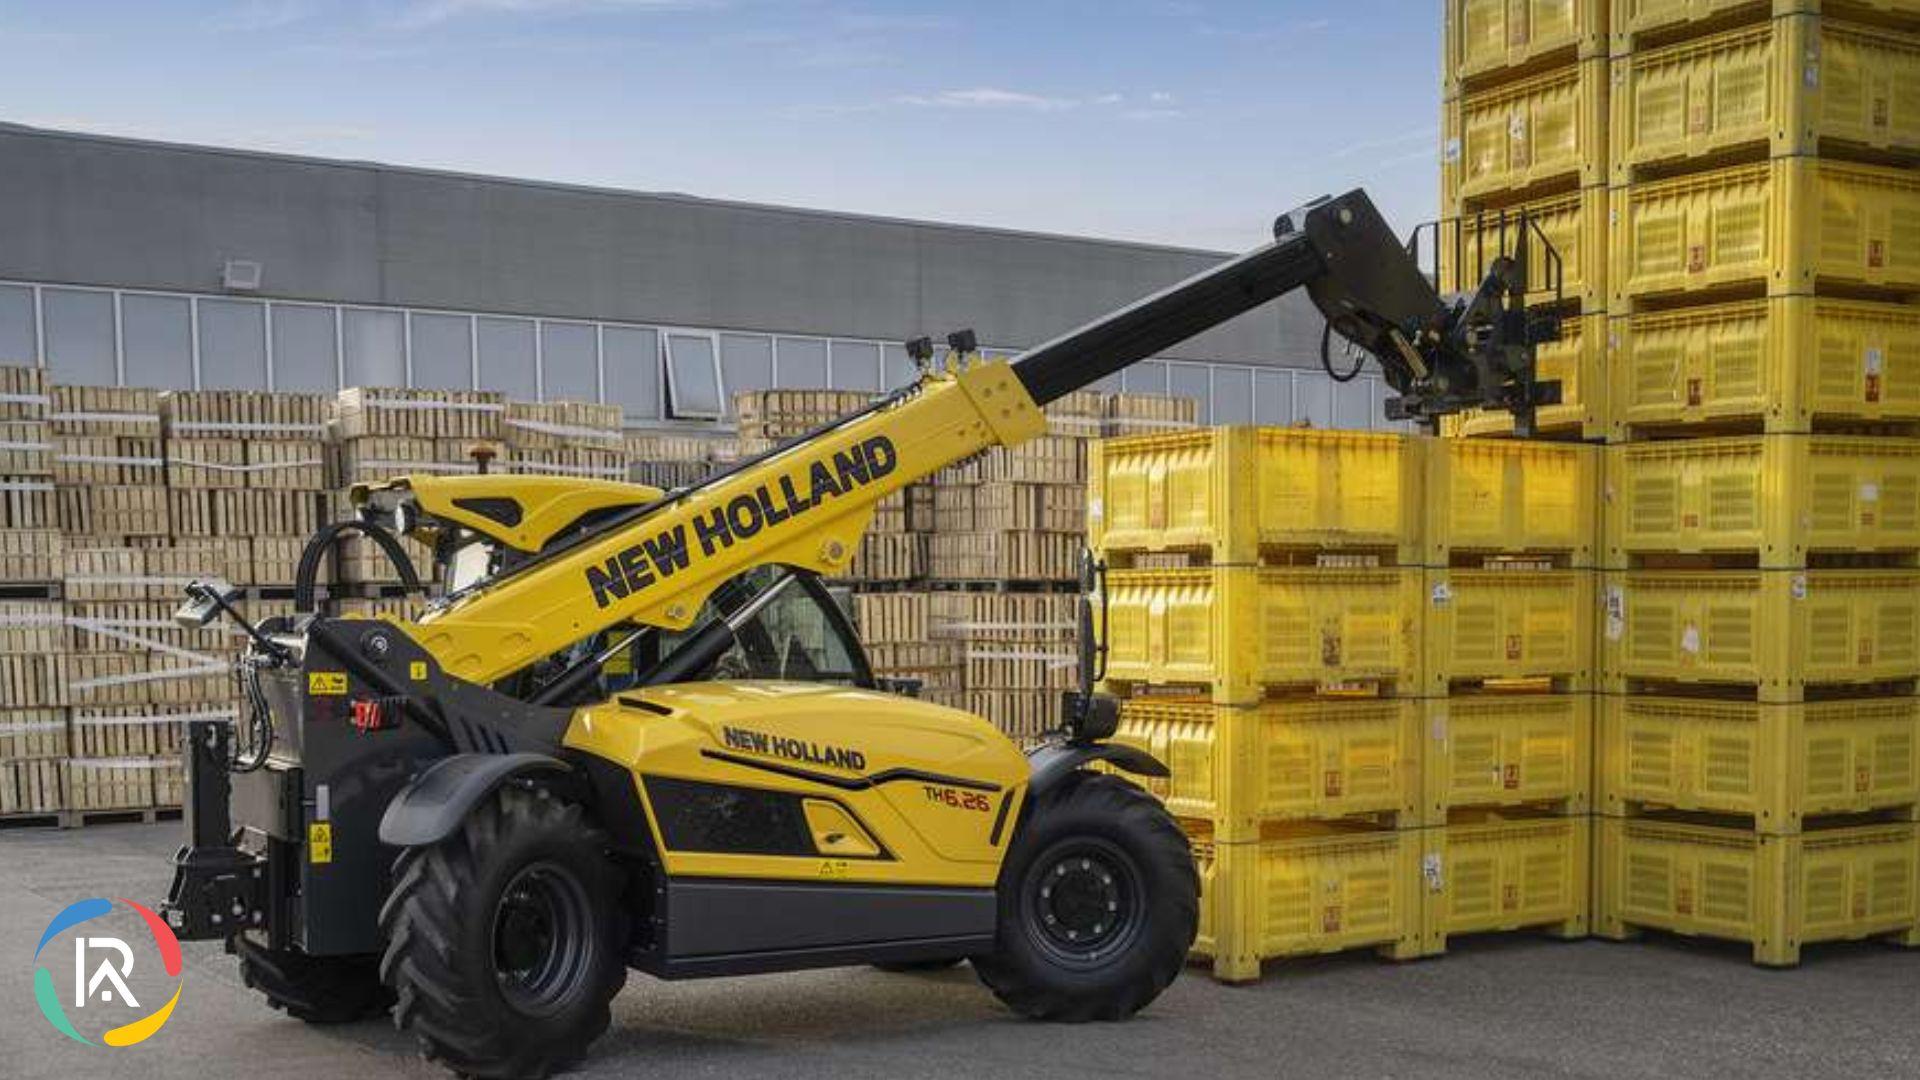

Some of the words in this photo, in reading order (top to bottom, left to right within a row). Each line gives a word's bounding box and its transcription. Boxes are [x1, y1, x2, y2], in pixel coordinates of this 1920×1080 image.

[585, 524, 689, 609] NEW
[692, 436, 897, 556] HOLLAND
[723, 725, 769, 753] NEW
[772, 735, 866, 770] HOLLAND
